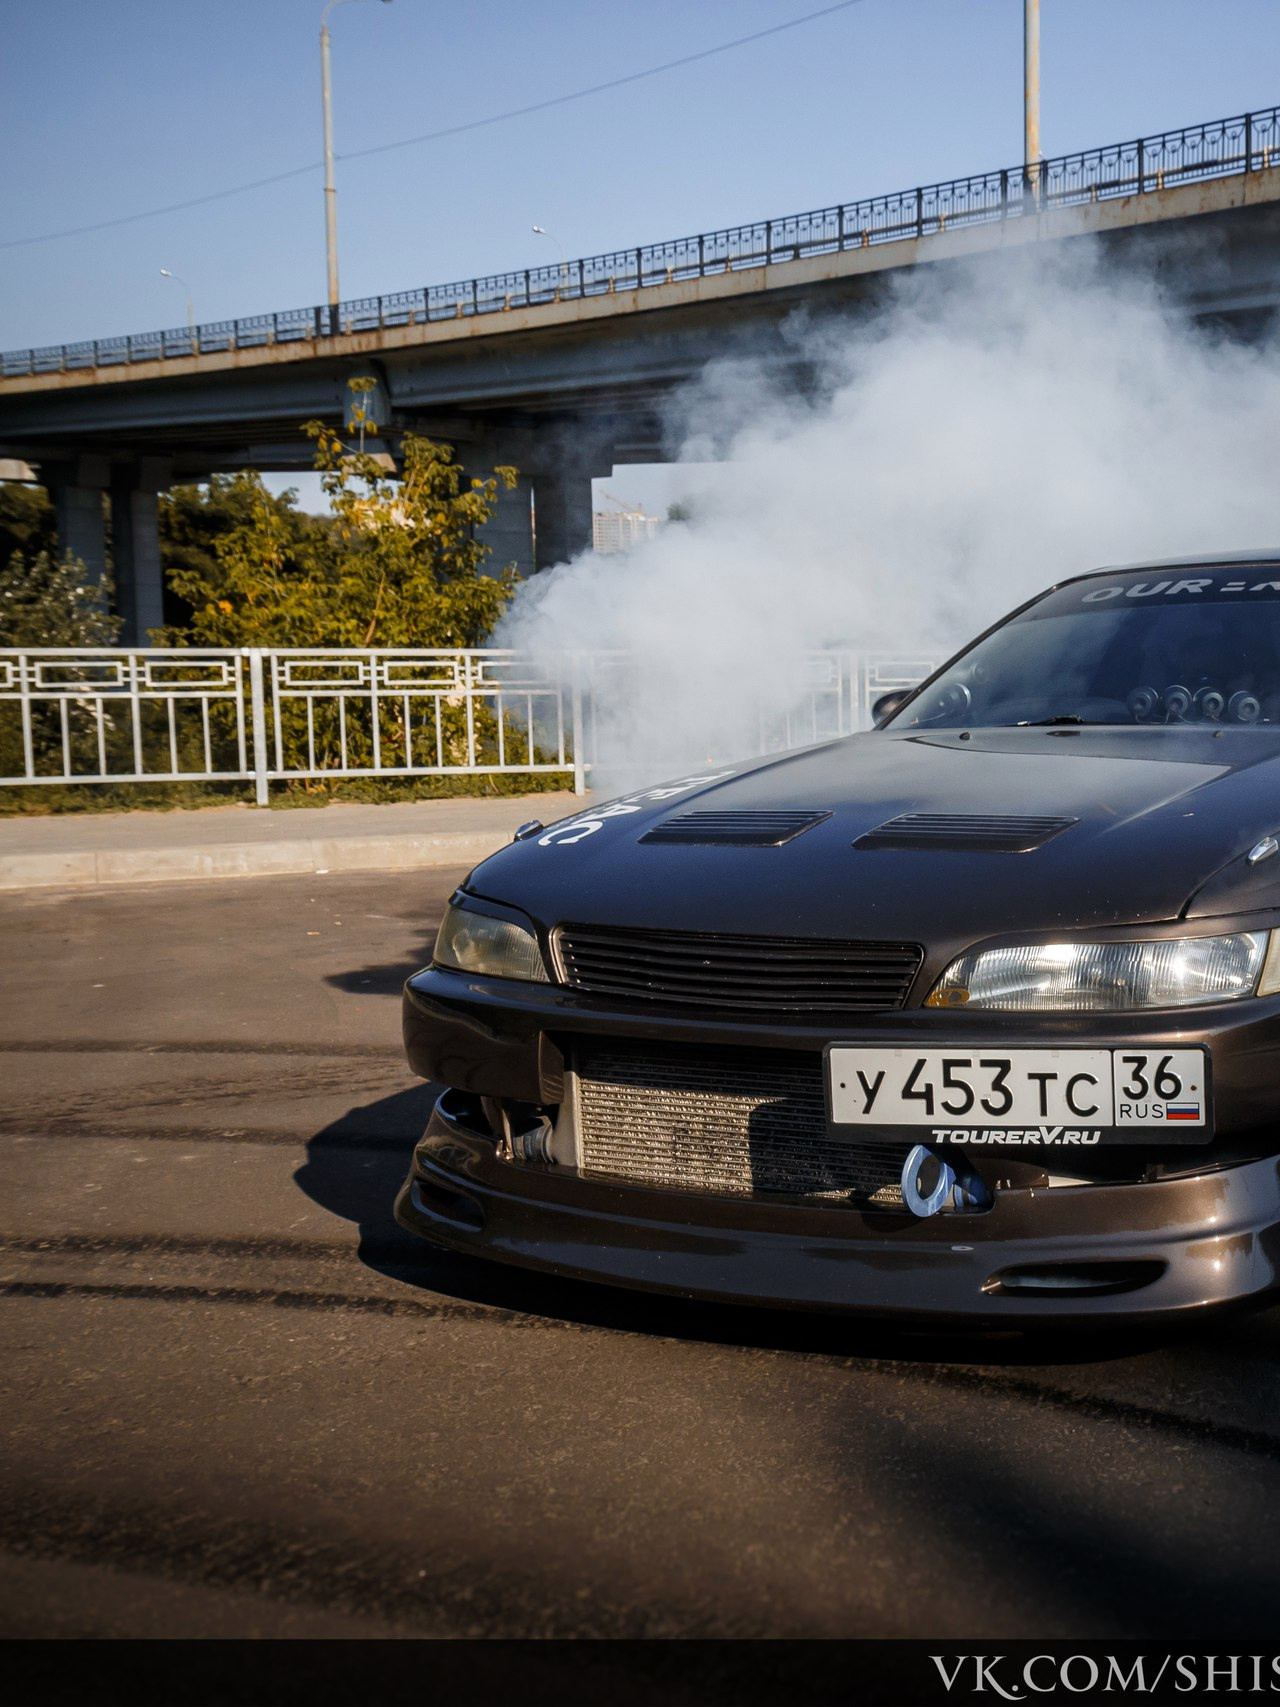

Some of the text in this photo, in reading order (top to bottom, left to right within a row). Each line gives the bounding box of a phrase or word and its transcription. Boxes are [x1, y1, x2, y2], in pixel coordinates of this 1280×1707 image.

[1121, 1055, 1183, 1100] 36
[1119, 1103, 1164, 1119] RUS
[931, 1125, 1101, 1145] TOURERV.RU
